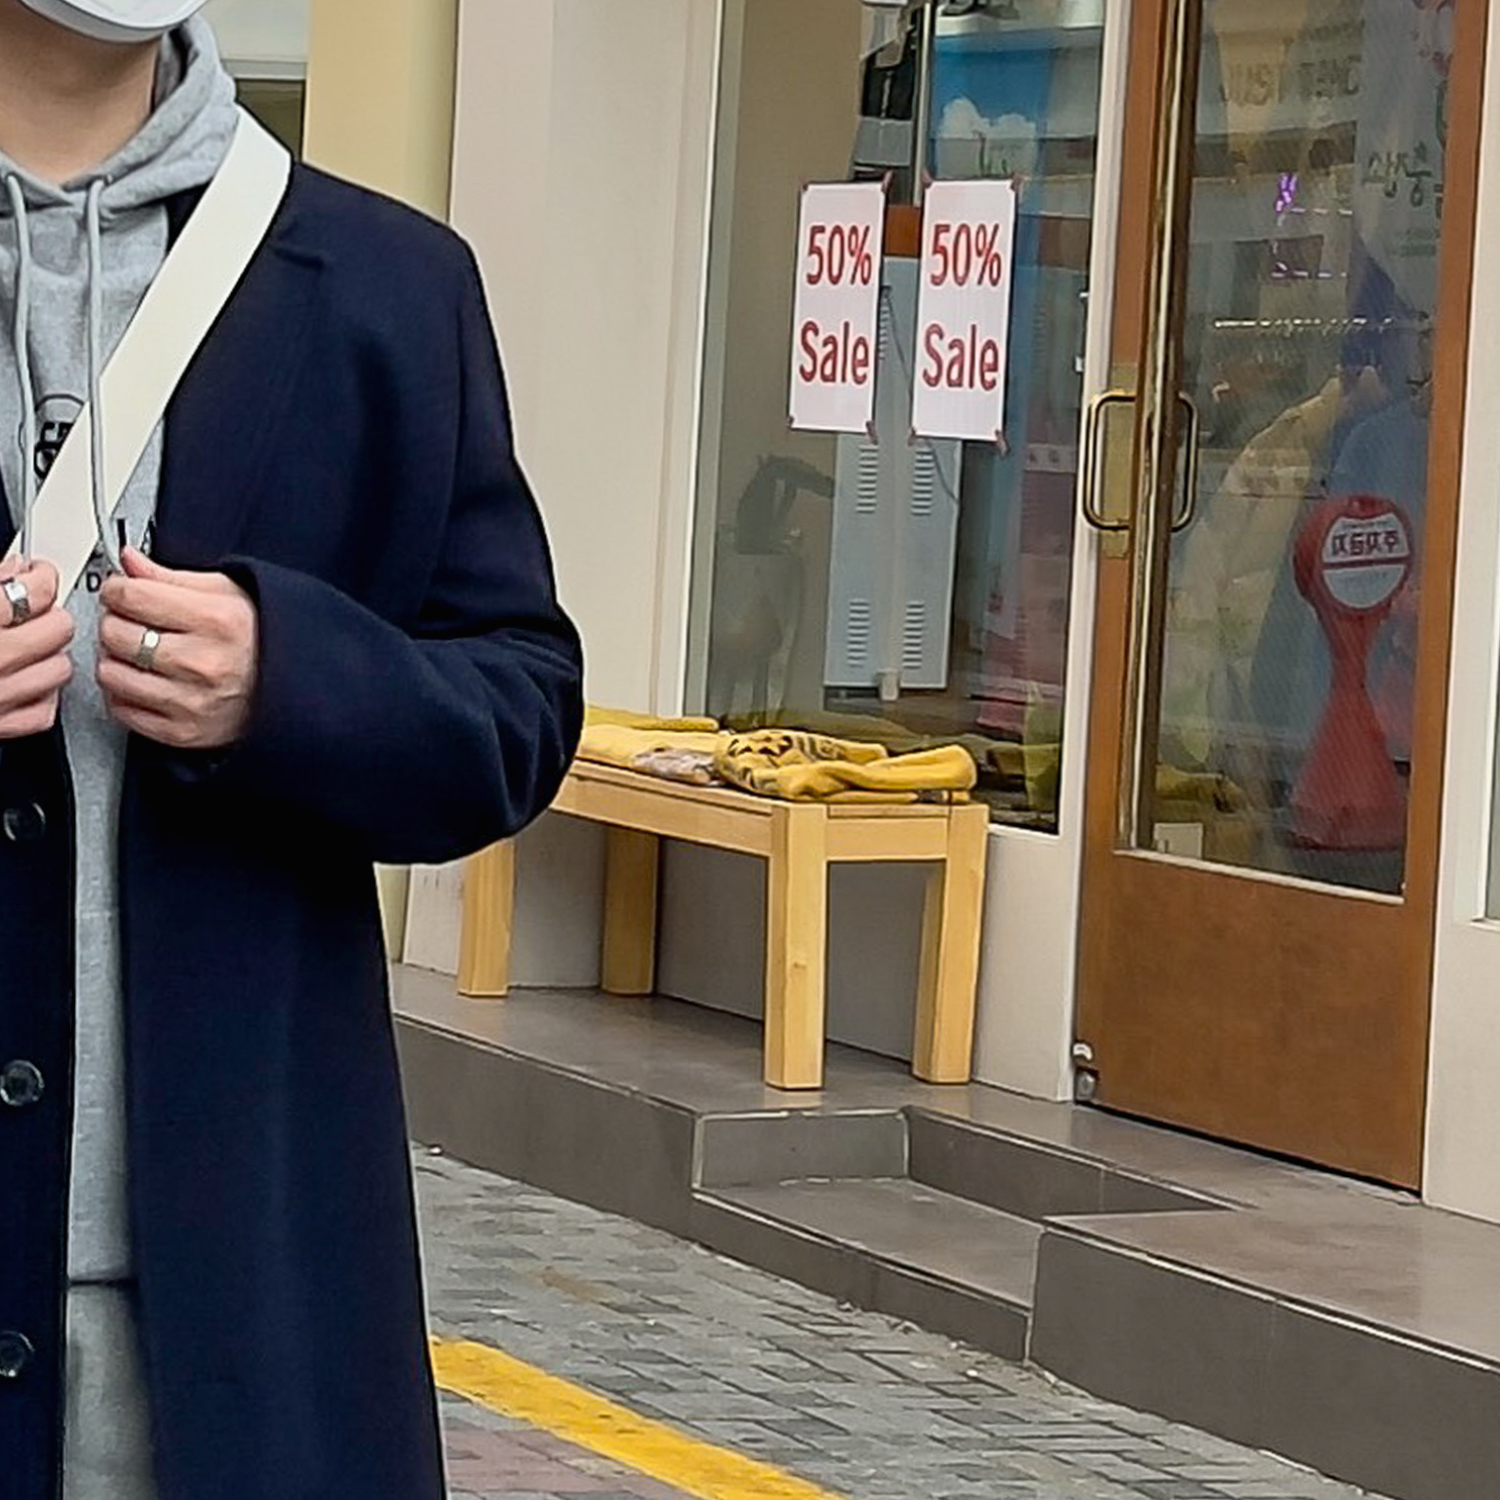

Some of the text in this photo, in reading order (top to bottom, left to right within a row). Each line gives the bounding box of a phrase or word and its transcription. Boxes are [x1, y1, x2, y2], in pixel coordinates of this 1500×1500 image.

[806, 225, 872, 286] 50%
[930, 223, 1002, 287] 50%
[799, 321, 869, 385] Sale
[922, 324, 999, 391] Sale
